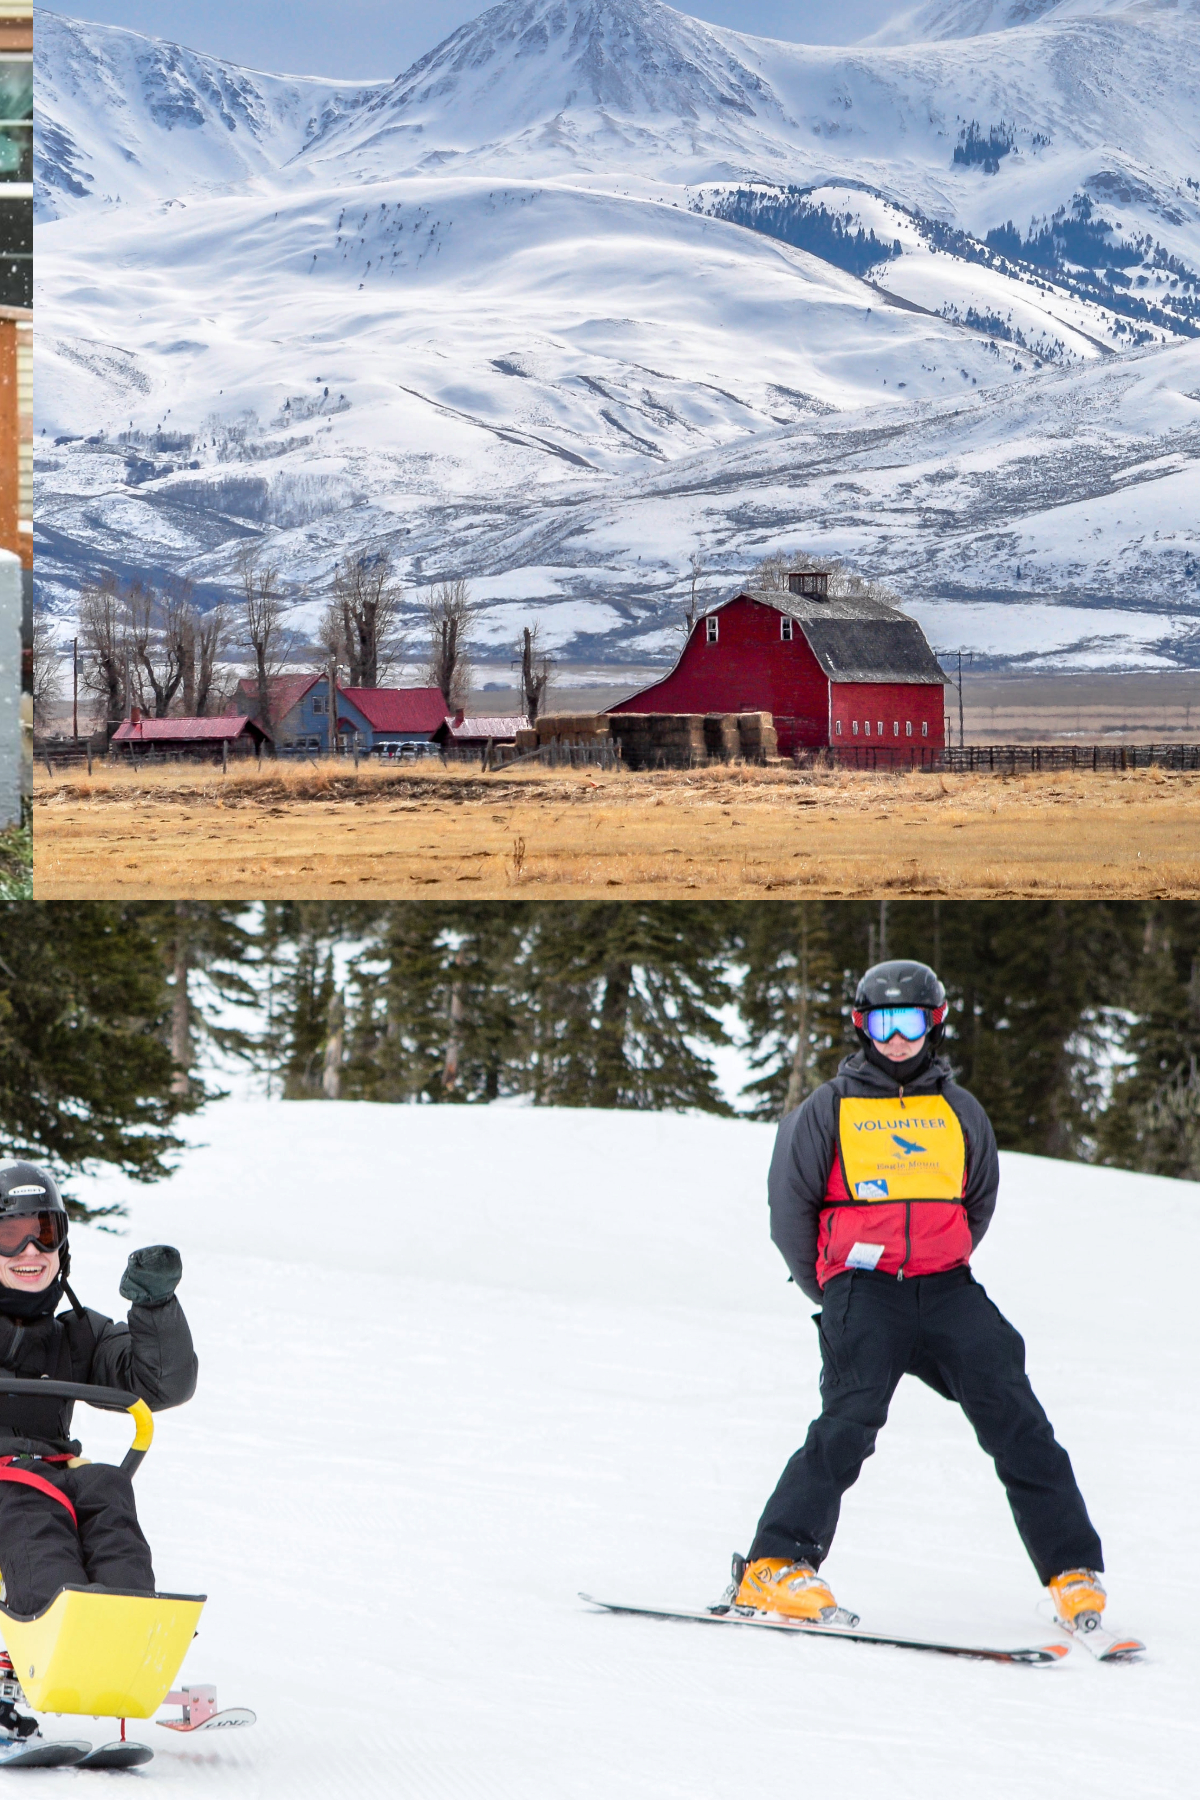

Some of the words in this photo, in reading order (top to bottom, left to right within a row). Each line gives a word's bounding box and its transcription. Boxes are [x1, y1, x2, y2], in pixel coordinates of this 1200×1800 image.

[854, 1118, 947, 1132] VOLUNTEER
[877, 1162, 905, 1171] Eagle
[908, 1160, 940, 1169] Mount
